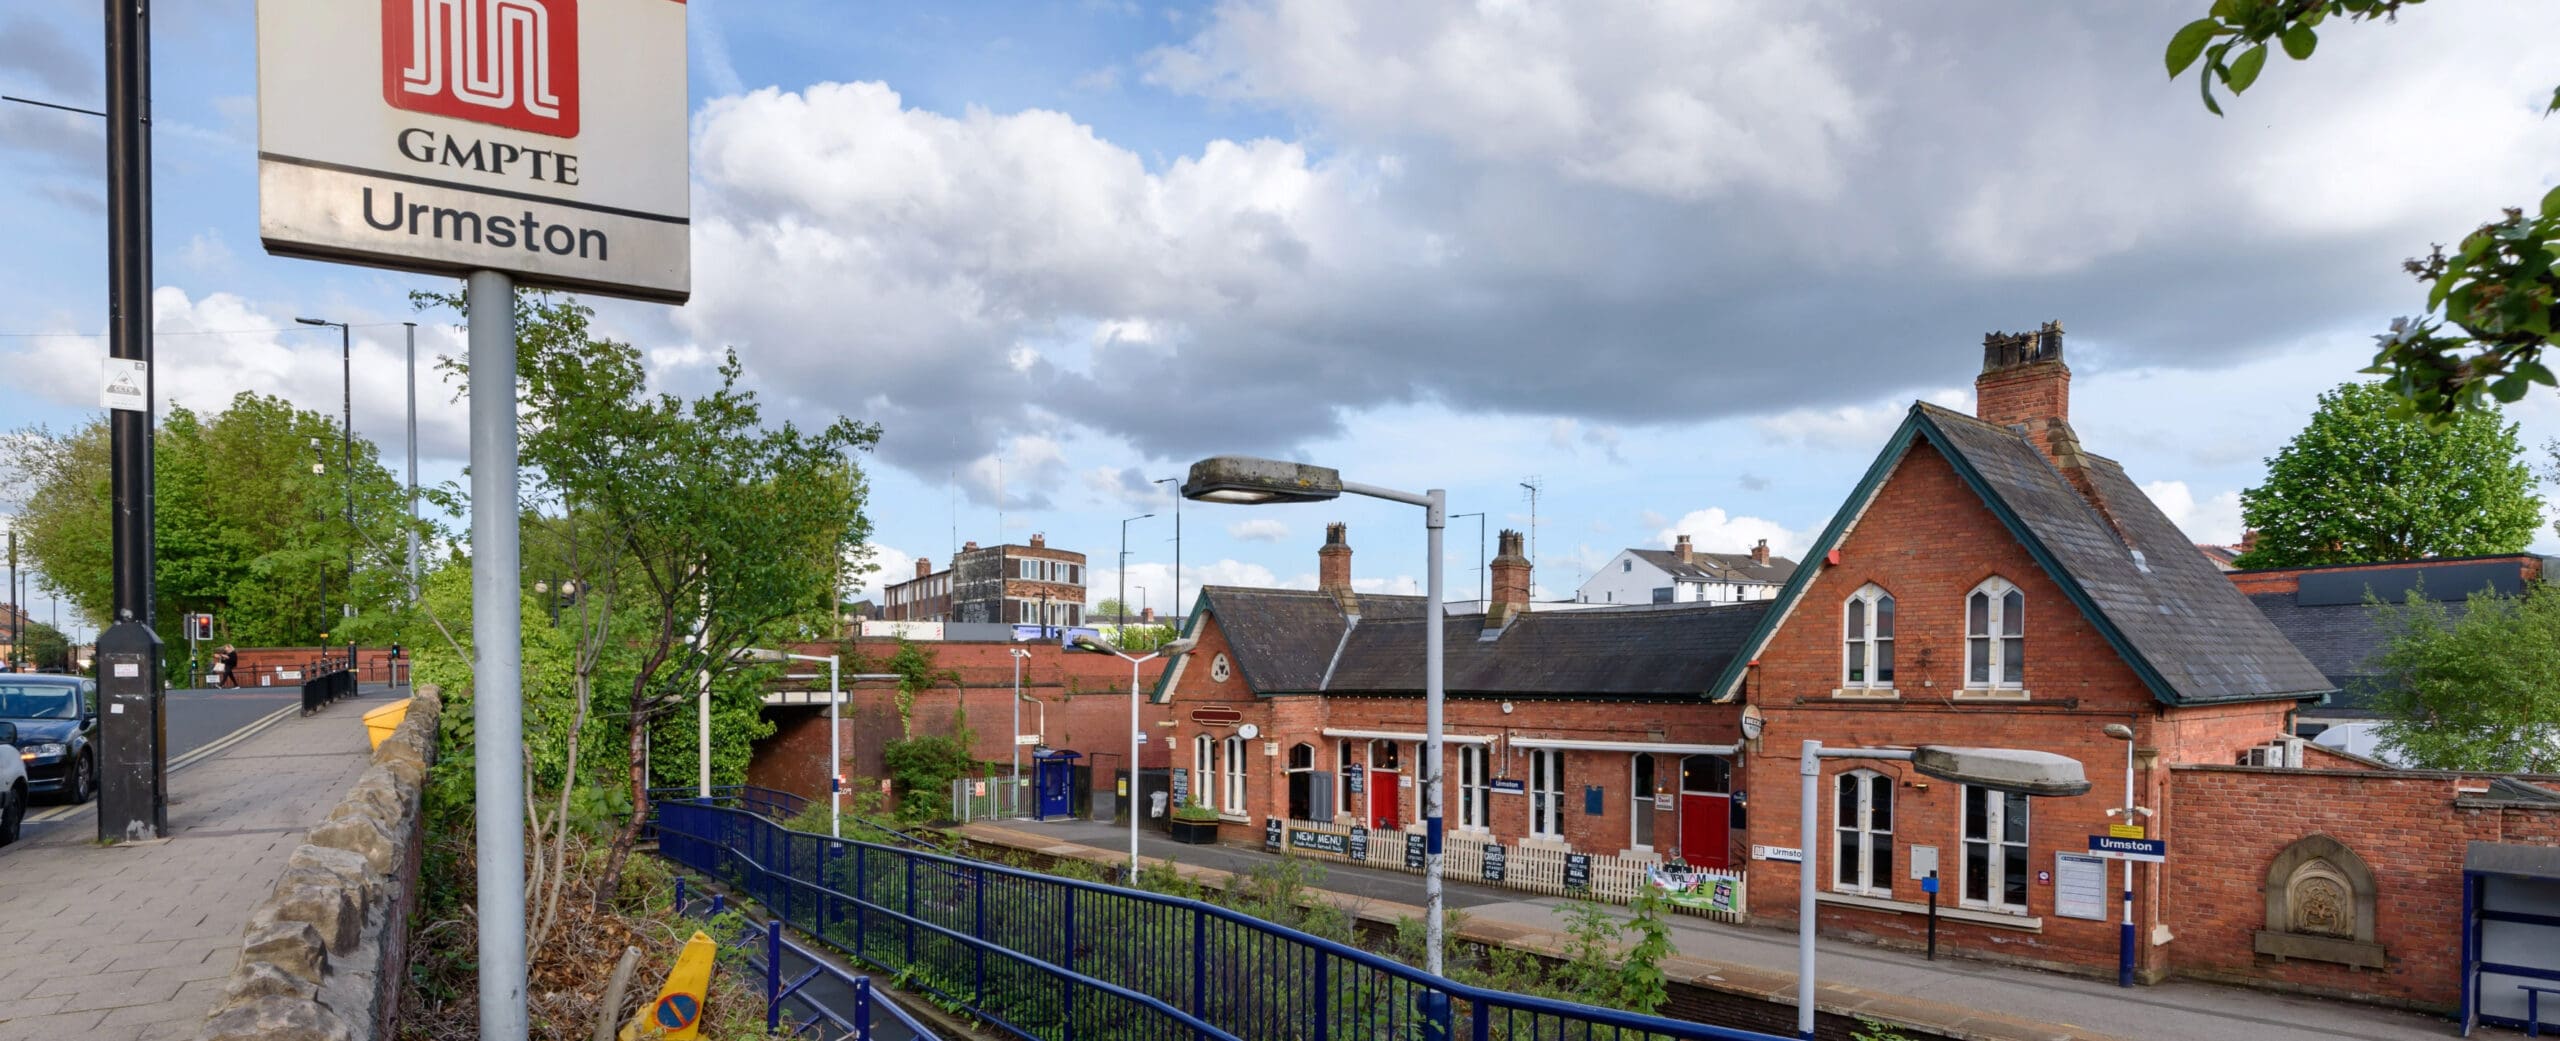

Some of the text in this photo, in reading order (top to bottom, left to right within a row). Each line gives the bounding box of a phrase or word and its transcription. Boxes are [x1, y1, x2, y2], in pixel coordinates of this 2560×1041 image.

[397, 127, 580, 186] GMPTE
[363, 187, 607, 260] Urmston
[1296, 832, 1314, 842] NEW
[1317, 834, 1342, 846] MENU
[2101, 838, 2152, 851] Urmston
[1772, 847, 1802, 858] Urmsto
[1571, 855, 1585, 864] HOT
[1570, 870, 1585, 878] REAL
